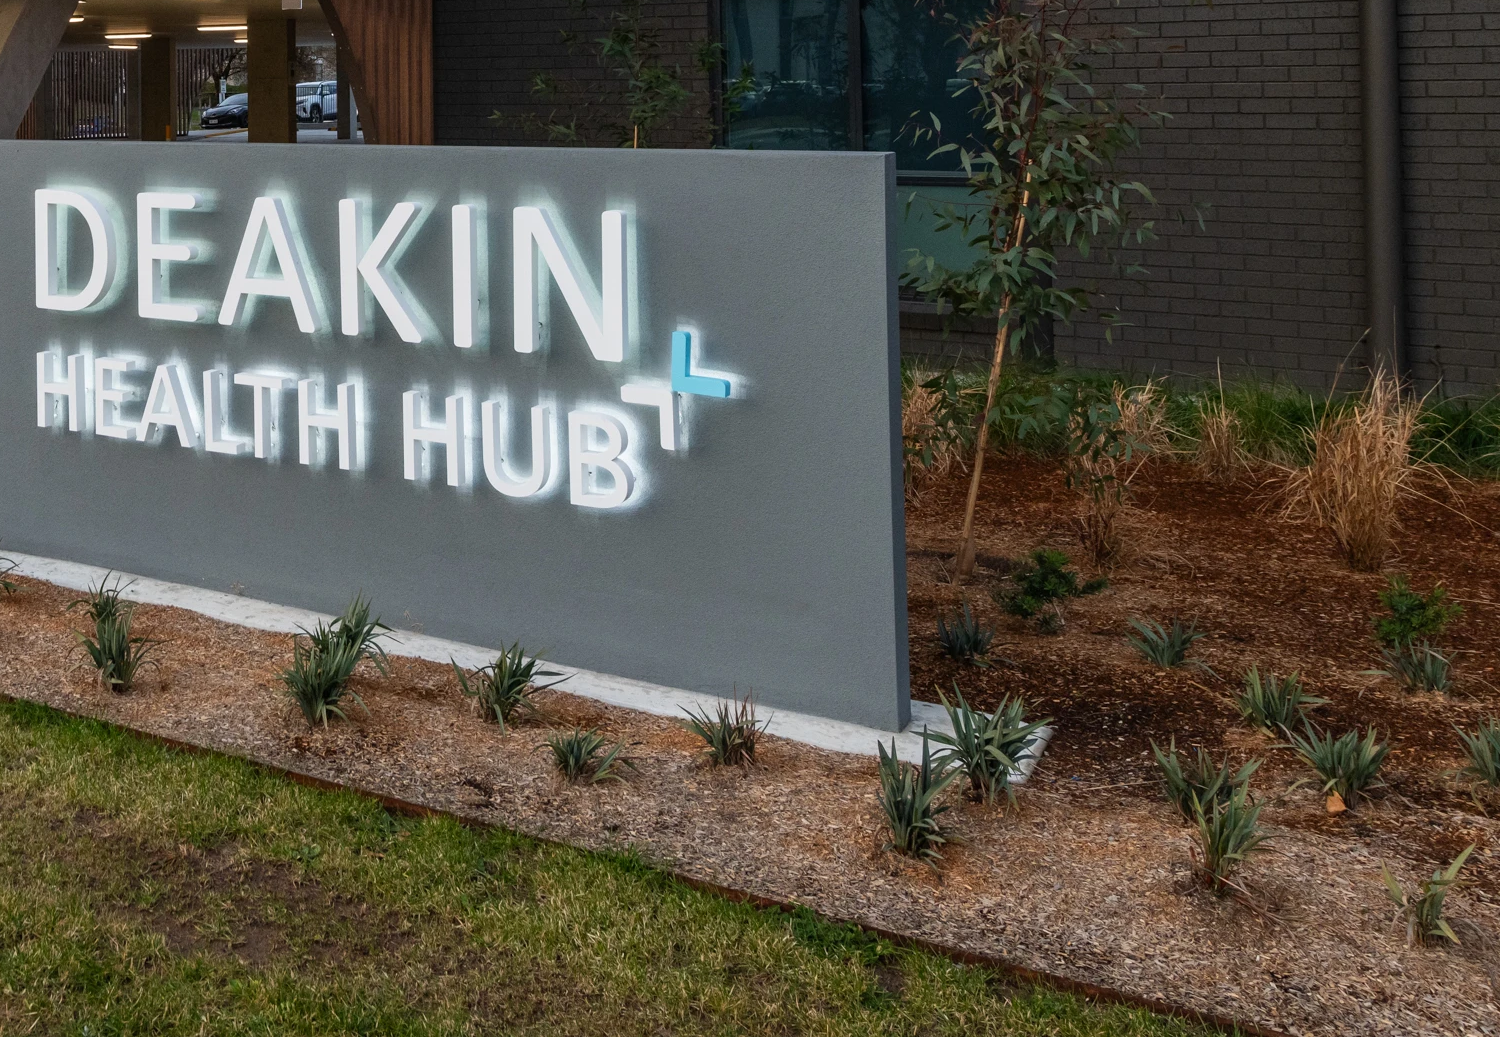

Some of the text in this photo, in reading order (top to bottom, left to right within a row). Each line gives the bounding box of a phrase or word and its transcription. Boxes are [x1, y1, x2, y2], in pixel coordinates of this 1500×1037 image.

[35, 188, 627, 363] DEAKIN
[36, 350, 635, 509] HEALTH HUB
